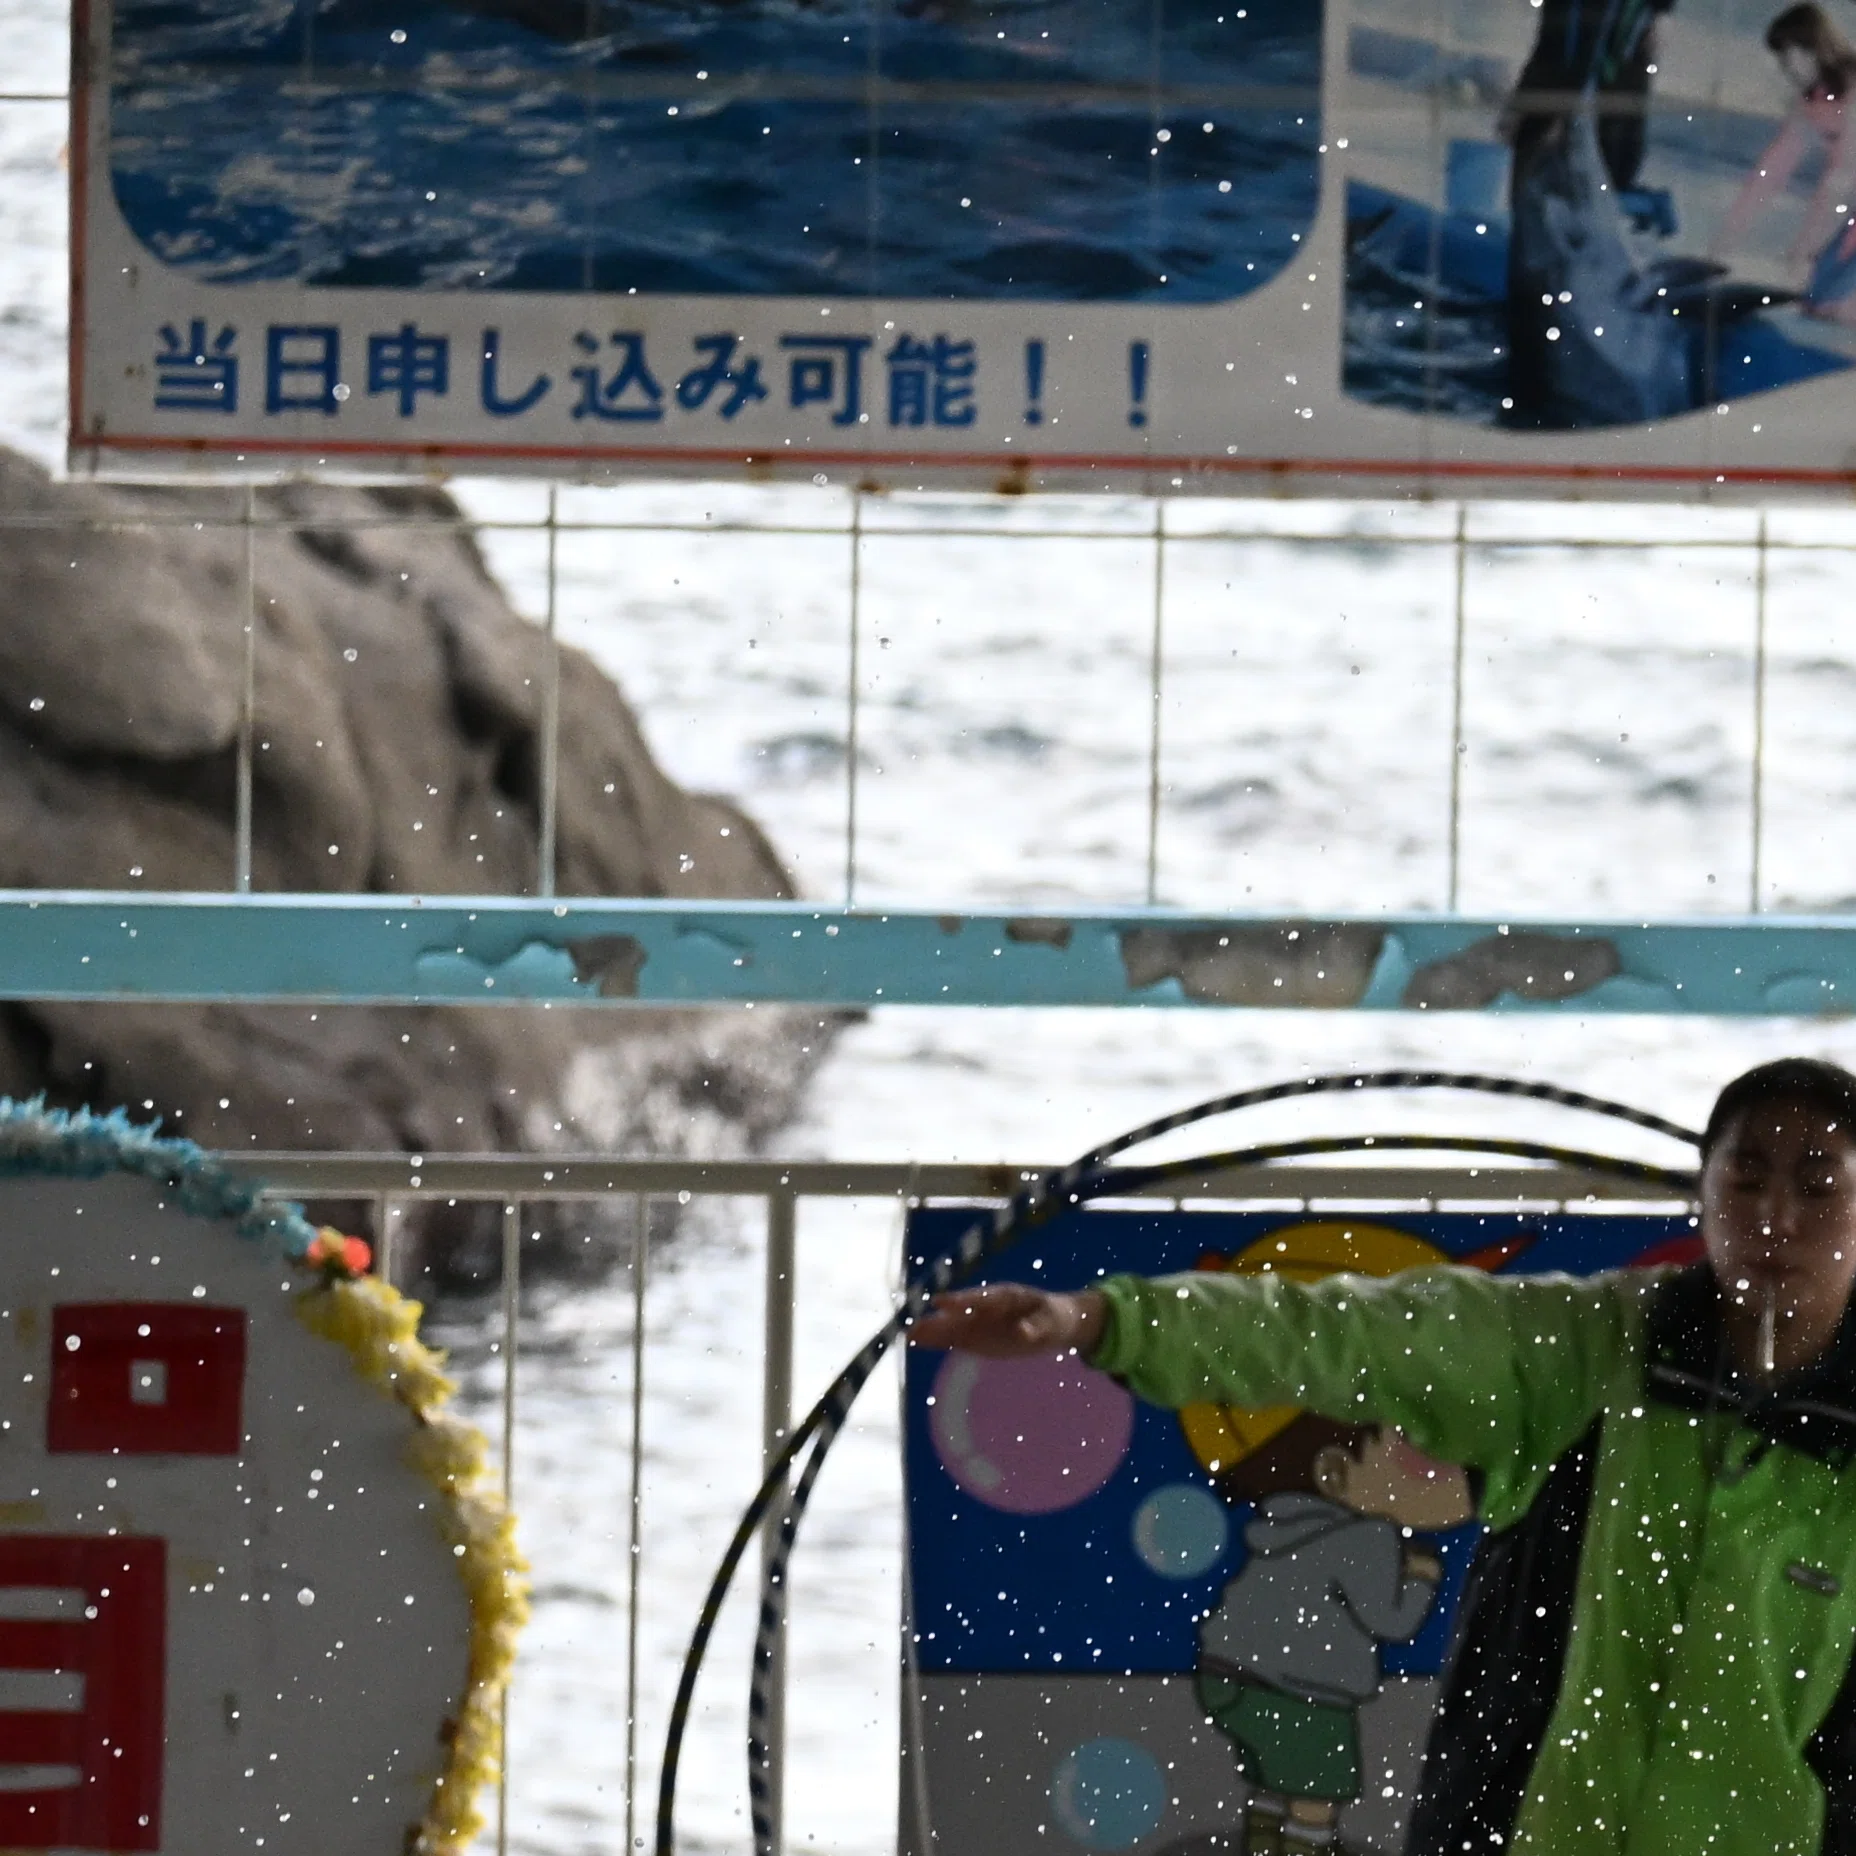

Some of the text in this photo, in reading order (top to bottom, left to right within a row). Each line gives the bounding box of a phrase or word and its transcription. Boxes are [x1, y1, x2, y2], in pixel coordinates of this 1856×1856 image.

[154, 319, 1151, 429] 当日申し込み可能！！
